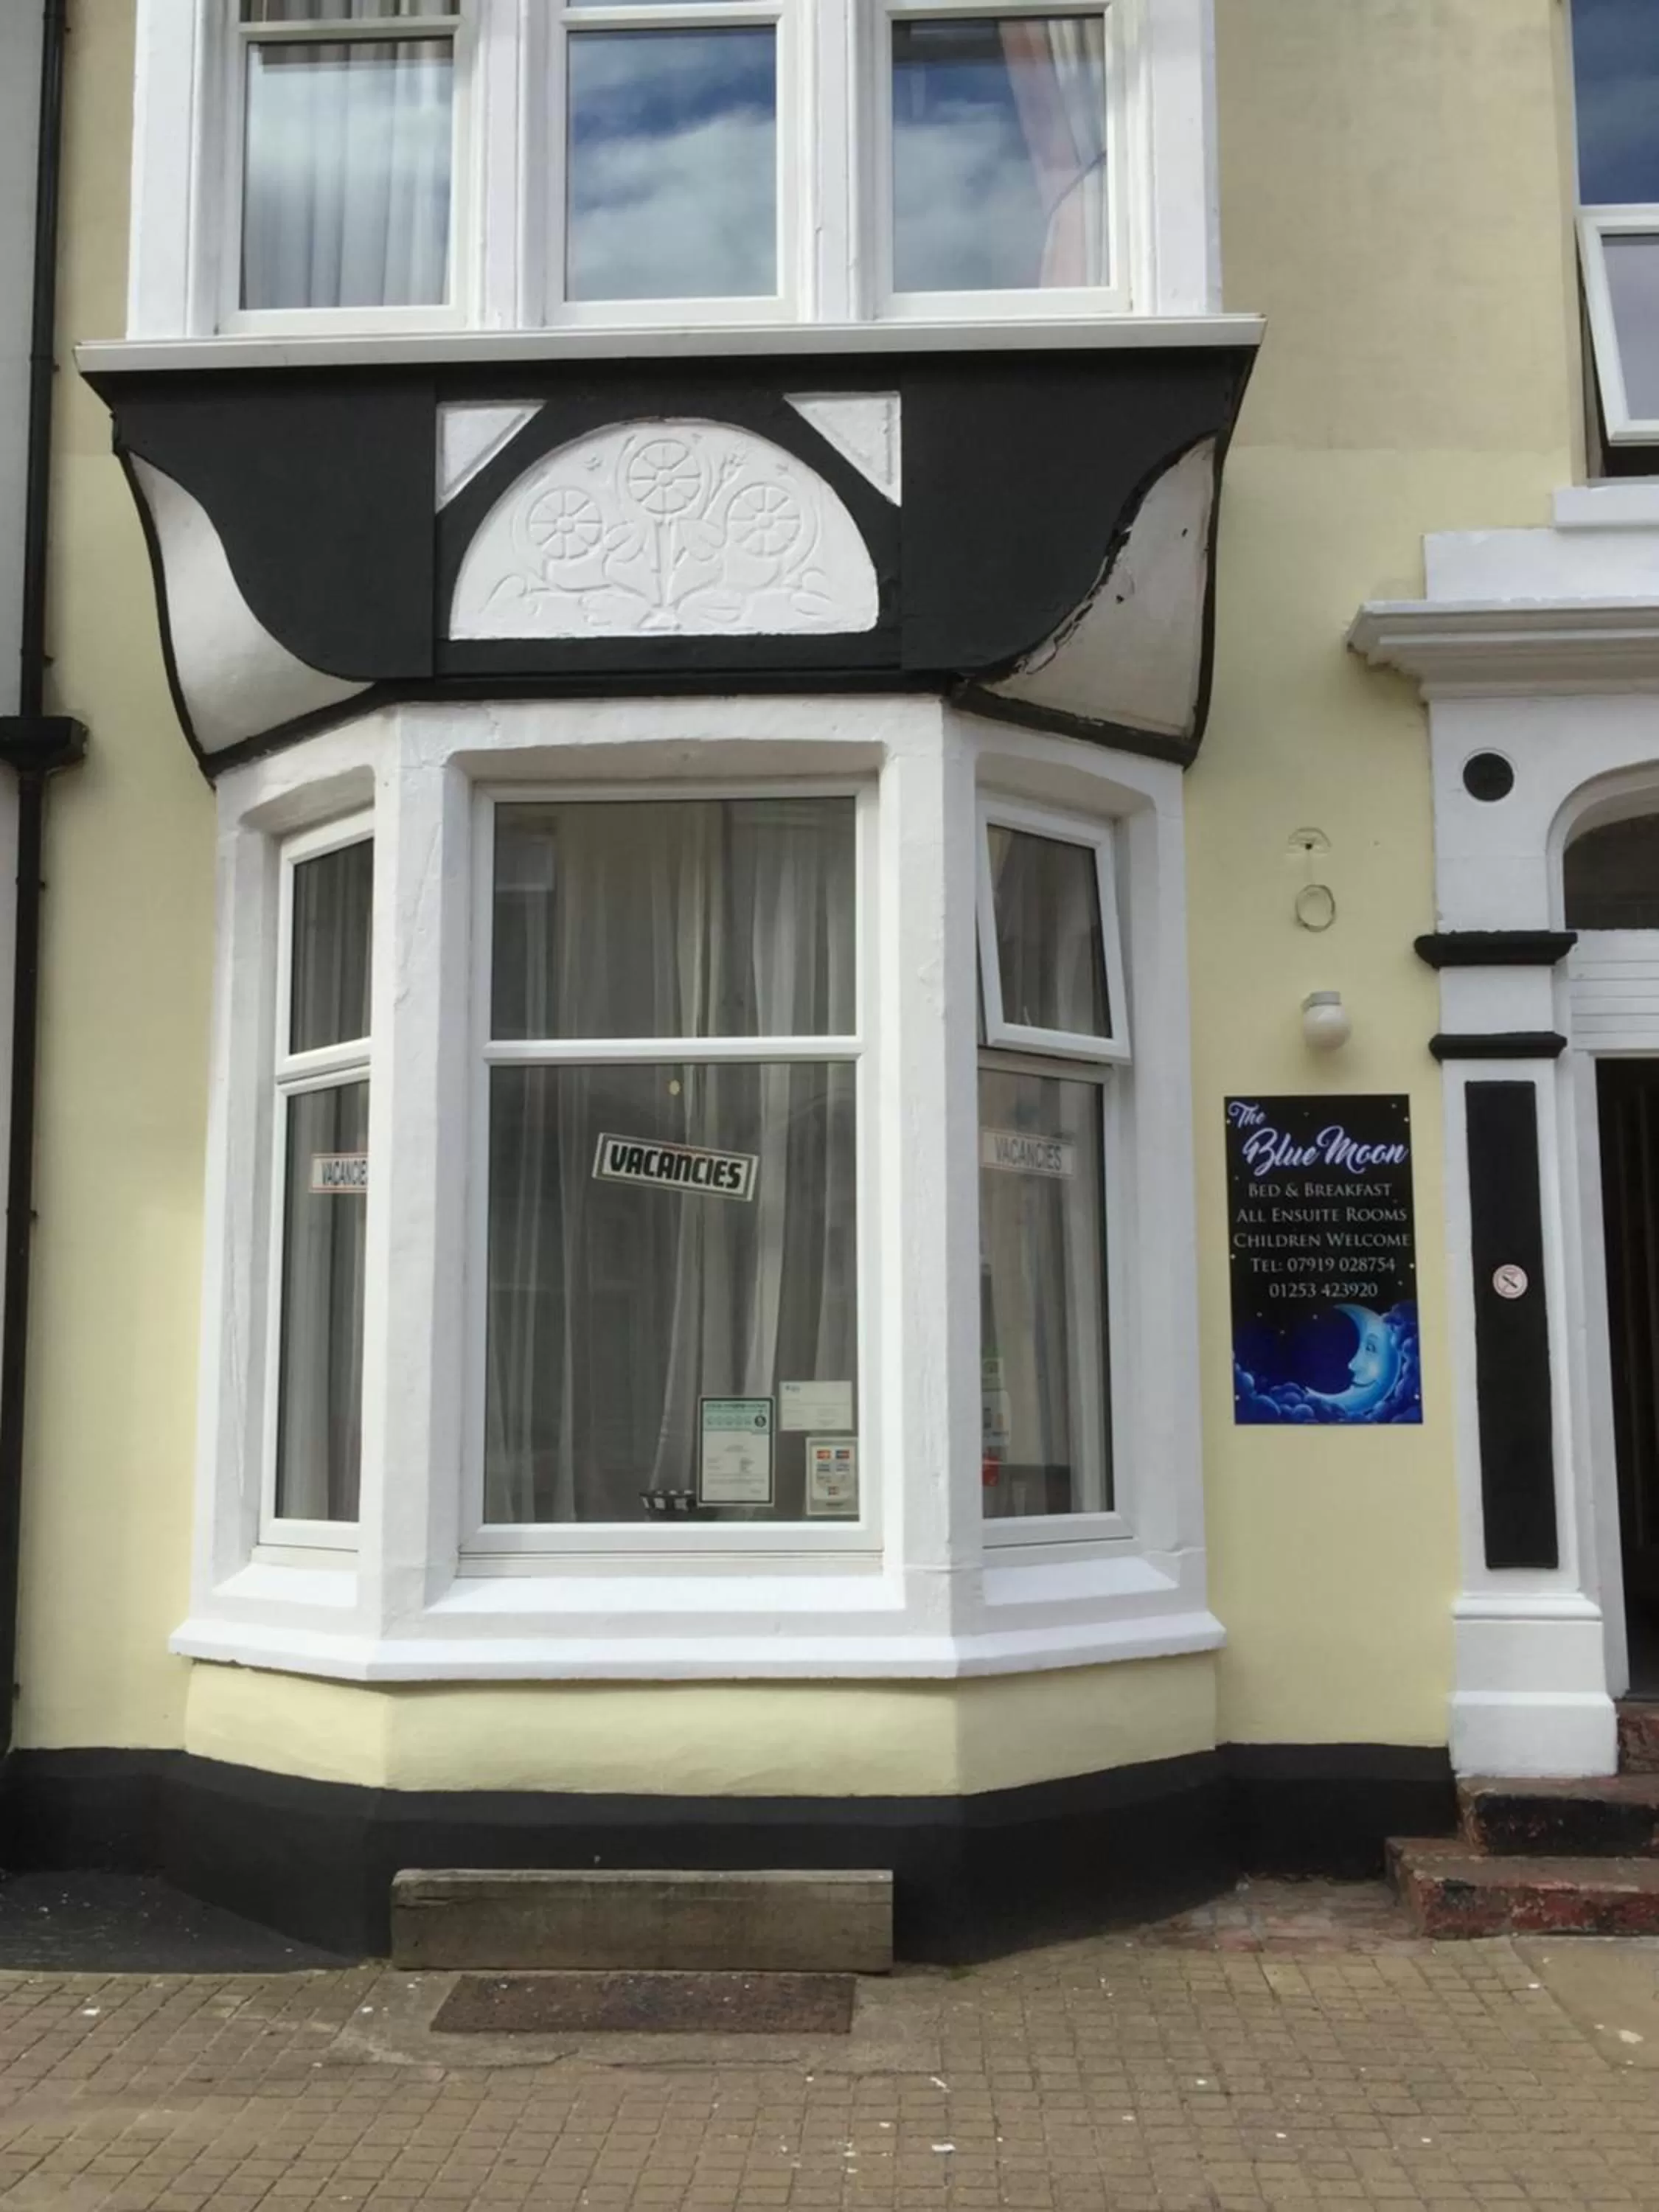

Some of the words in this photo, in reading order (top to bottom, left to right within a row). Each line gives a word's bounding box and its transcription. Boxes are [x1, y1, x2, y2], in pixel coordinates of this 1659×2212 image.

[1228, 1102, 1266, 1128] The
[1242, 1127, 1320, 1176] Blue
[1315, 1125, 1409, 1174] Moon
[321, 1160, 366, 1186] VACANCIE
[610, 1144, 742, 1189] VACANCIES
[1248, 1182, 1281, 1197] BED
[1285, 1182, 1298, 1197] &
[1304, 1182, 1392, 1197] BREAKFAST
[1236, 1208, 1266, 1222] ALL
[1271, 1207, 1340, 1222] ENSUITE
[1346, 1206, 1408, 1222] ROOMS
[1233, 1232, 1321, 1248] CHILDREN
[1325, 1232, 1412, 1248] WELCOME
[1287, 1256, 1335, 1273] 07919
[1338, 1256, 1396, 1273] 028754
[1269, 1282, 1317, 1298] 01253
[1321, 1281, 1379, 1298] 423920
